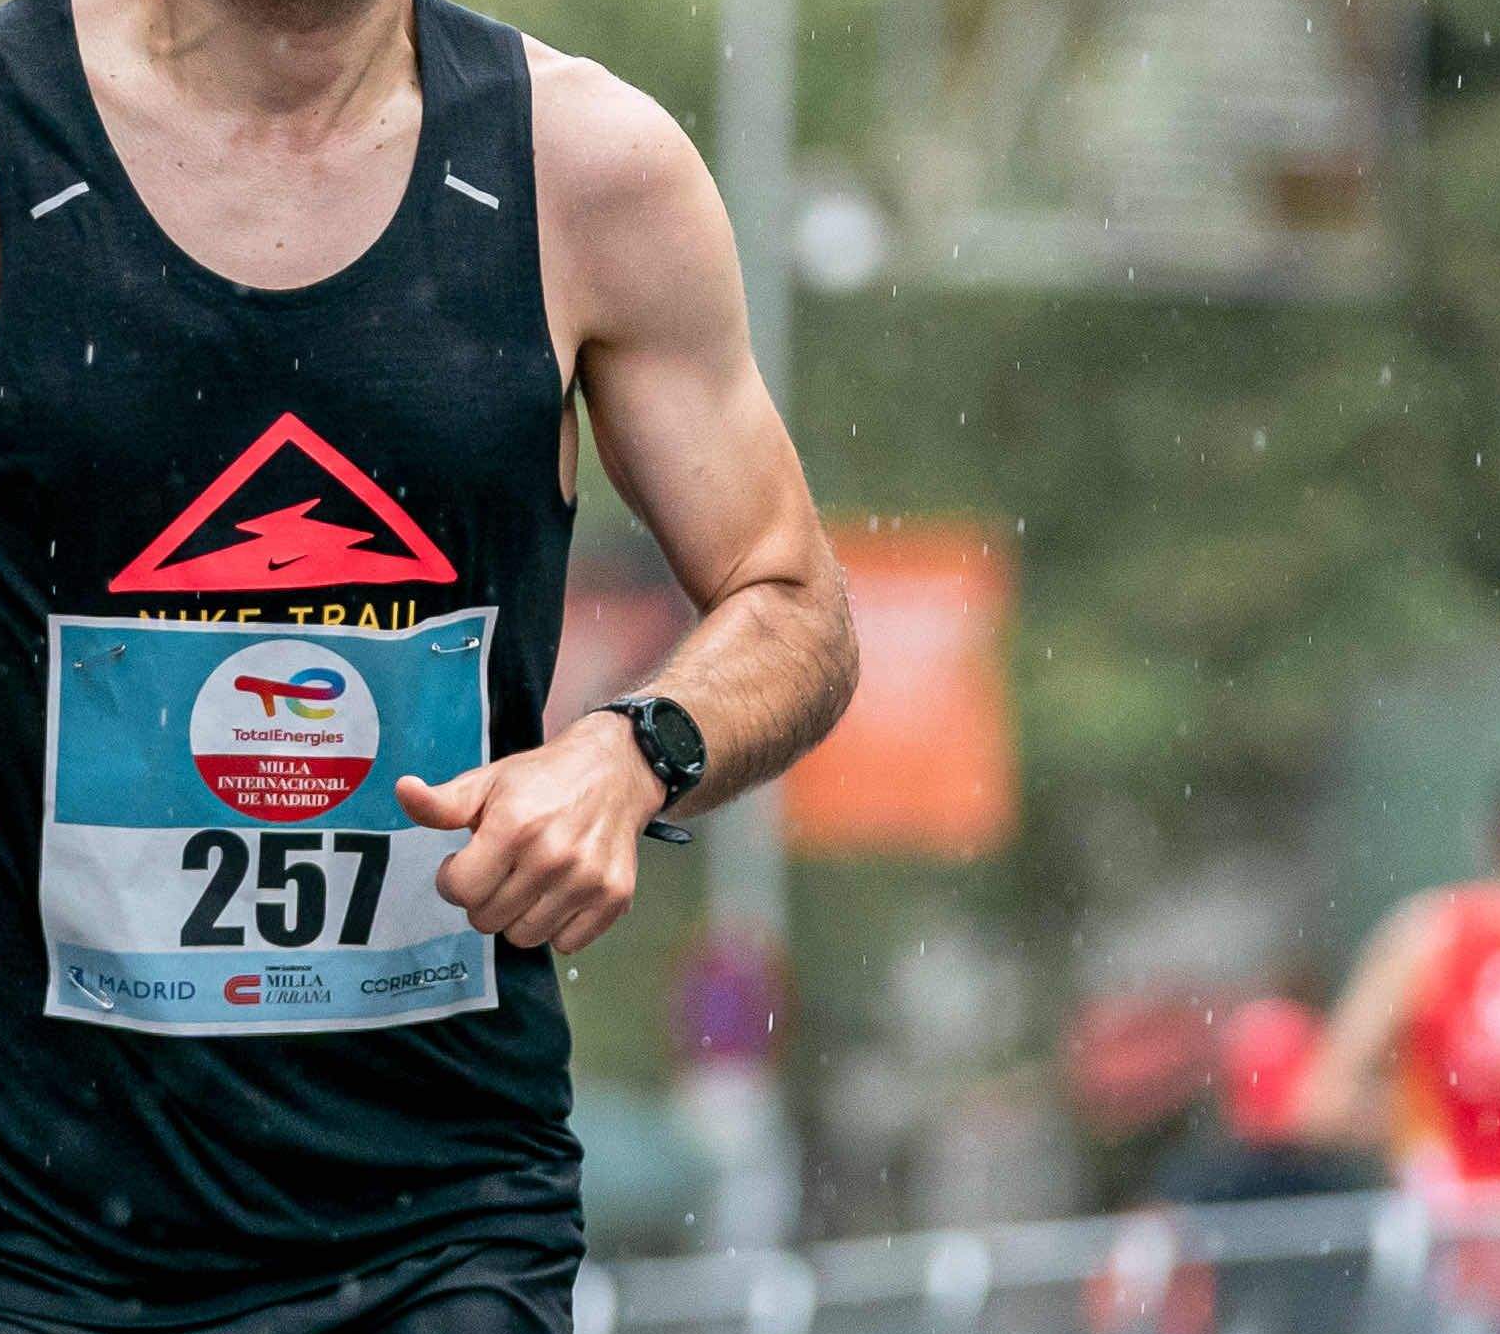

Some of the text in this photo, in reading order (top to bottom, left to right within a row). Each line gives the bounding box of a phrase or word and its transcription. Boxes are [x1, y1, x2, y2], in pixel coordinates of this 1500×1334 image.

[232, 728, 344, 747] TotalEnergies
[258, 760, 311, 775] MILLA
[238, 792, 330, 807] DE MADRID
[180, 829, 391, 948] 257
[100, 973, 197, 1000] MADRID
[265, 973, 323, 988] MILLA
